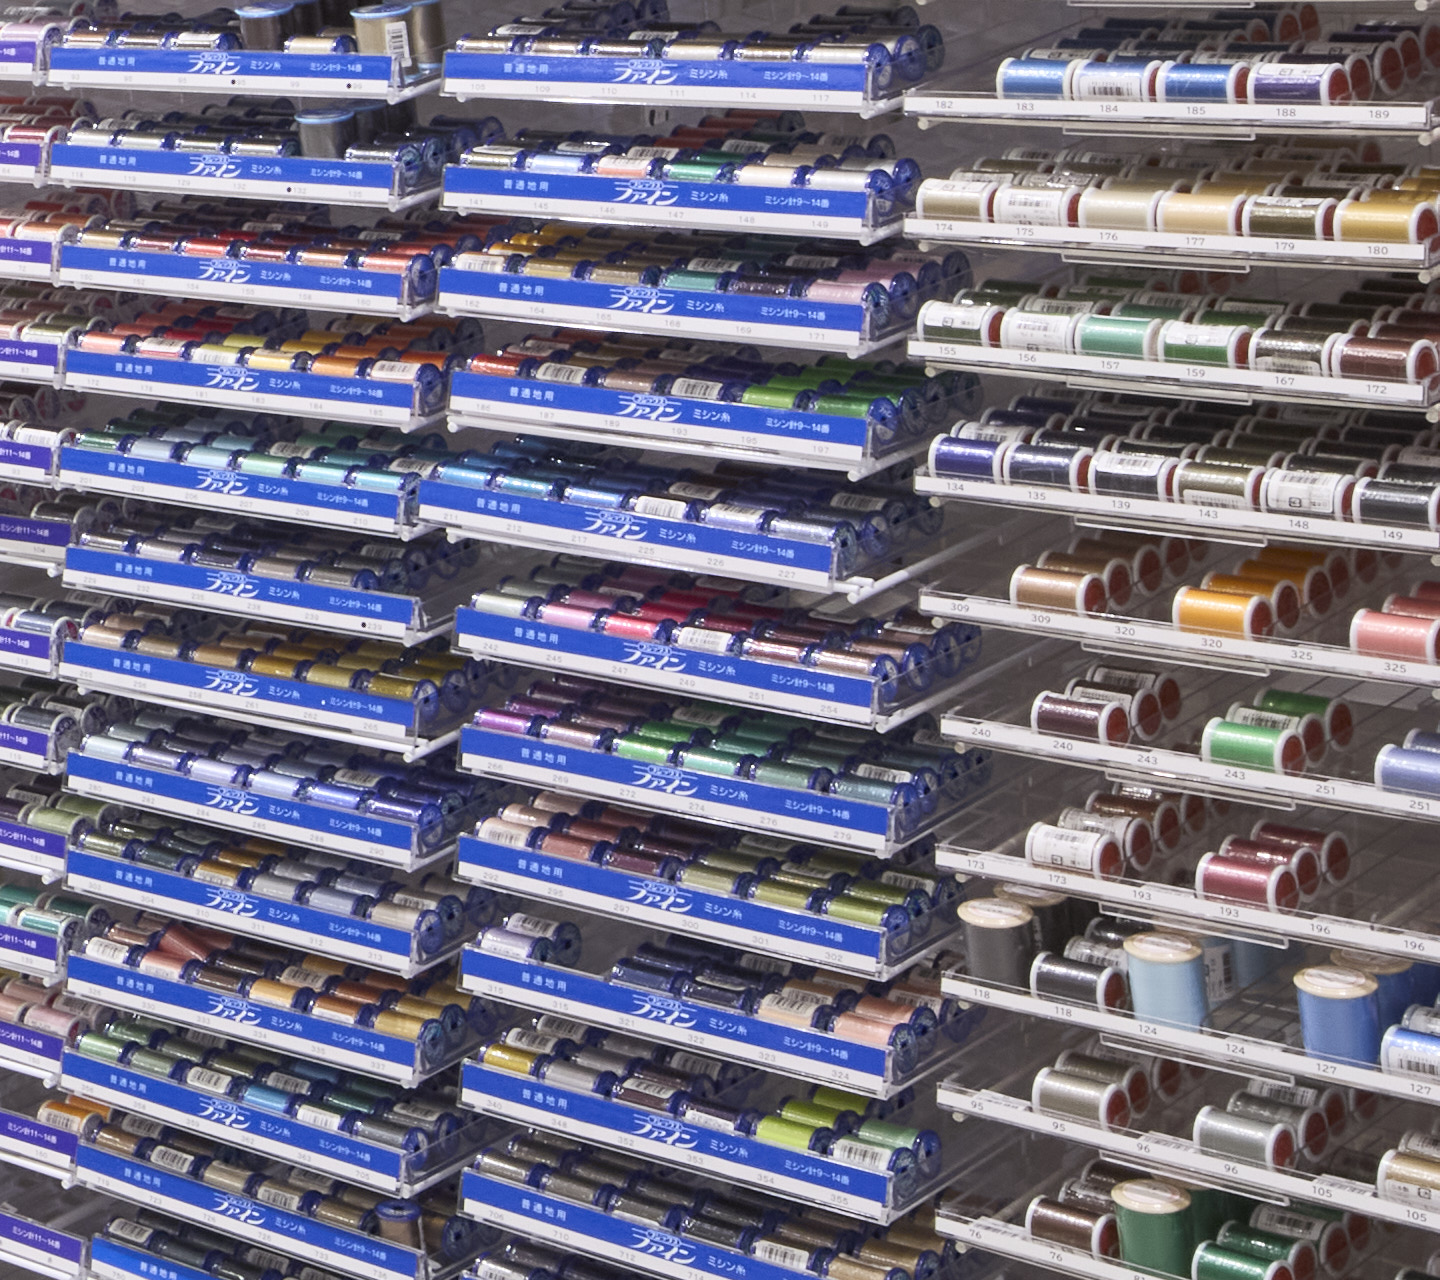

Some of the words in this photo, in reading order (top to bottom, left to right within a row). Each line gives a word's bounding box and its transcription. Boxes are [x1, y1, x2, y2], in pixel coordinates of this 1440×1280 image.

[1015, 102, 1035, 111] 183
[1186, 237, 1205, 245] 177
[1368, 385, 1386, 394] 172
[1384, 530, 1402, 540] 149
[1202, 638, 1222, 648] 320
[1054, 741, 1072, 750] 240
[1134, 890, 1151, 900] 193
[704, 901, 743, 922] ミシン糸
[1056, 1007, 1072, 1017] 118
[1052, 1121, 1067, 1133] 95
[1313, 1186, 1332, 1197] 105
